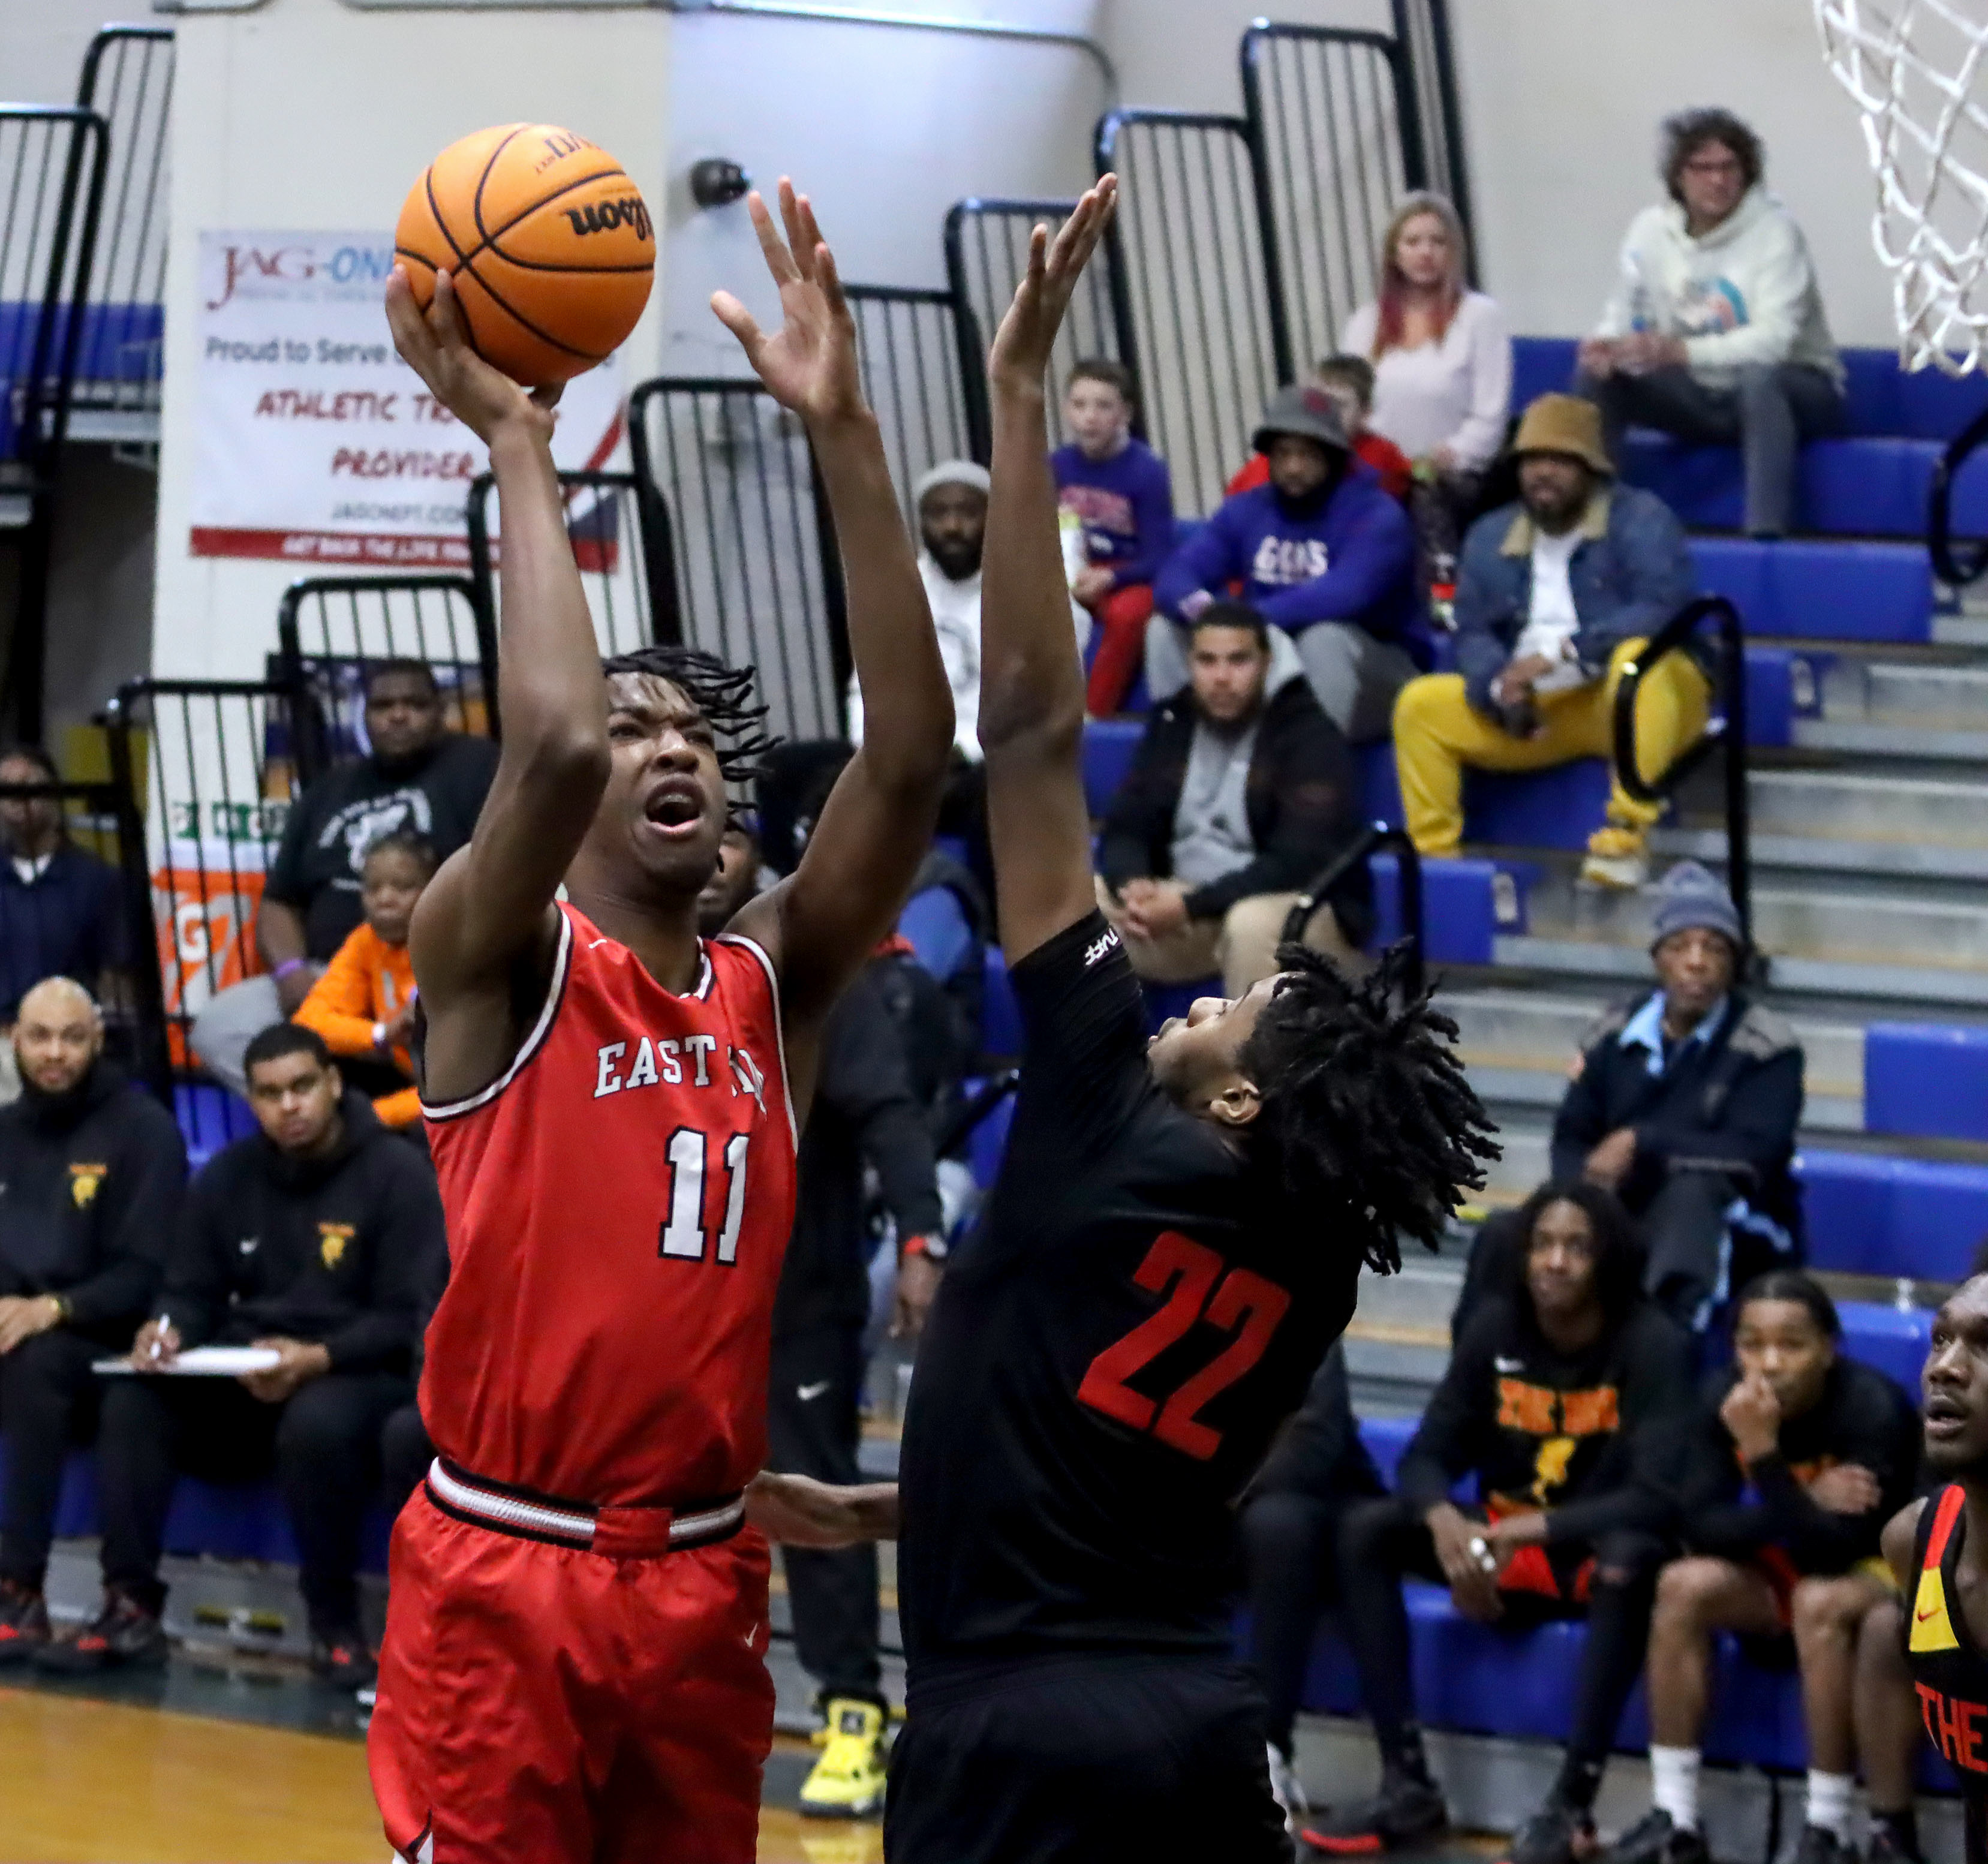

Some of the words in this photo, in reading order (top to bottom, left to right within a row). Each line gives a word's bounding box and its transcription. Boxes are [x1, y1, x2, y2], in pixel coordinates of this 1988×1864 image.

[206, 245, 394, 310] JAG-ON
[206, 336, 279, 362] Proud
[286, 338, 311, 363] to
[317, 337, 388, 364] Serve
[254, 389, 400, 422] ATHLETIC
[330, 445, 475, 480] PROVIDER
[594, 1034, 717, 1099] EAST
[659, 1125, 749, 1267] 11
[1078, 1229, 1292, 1461] 22
